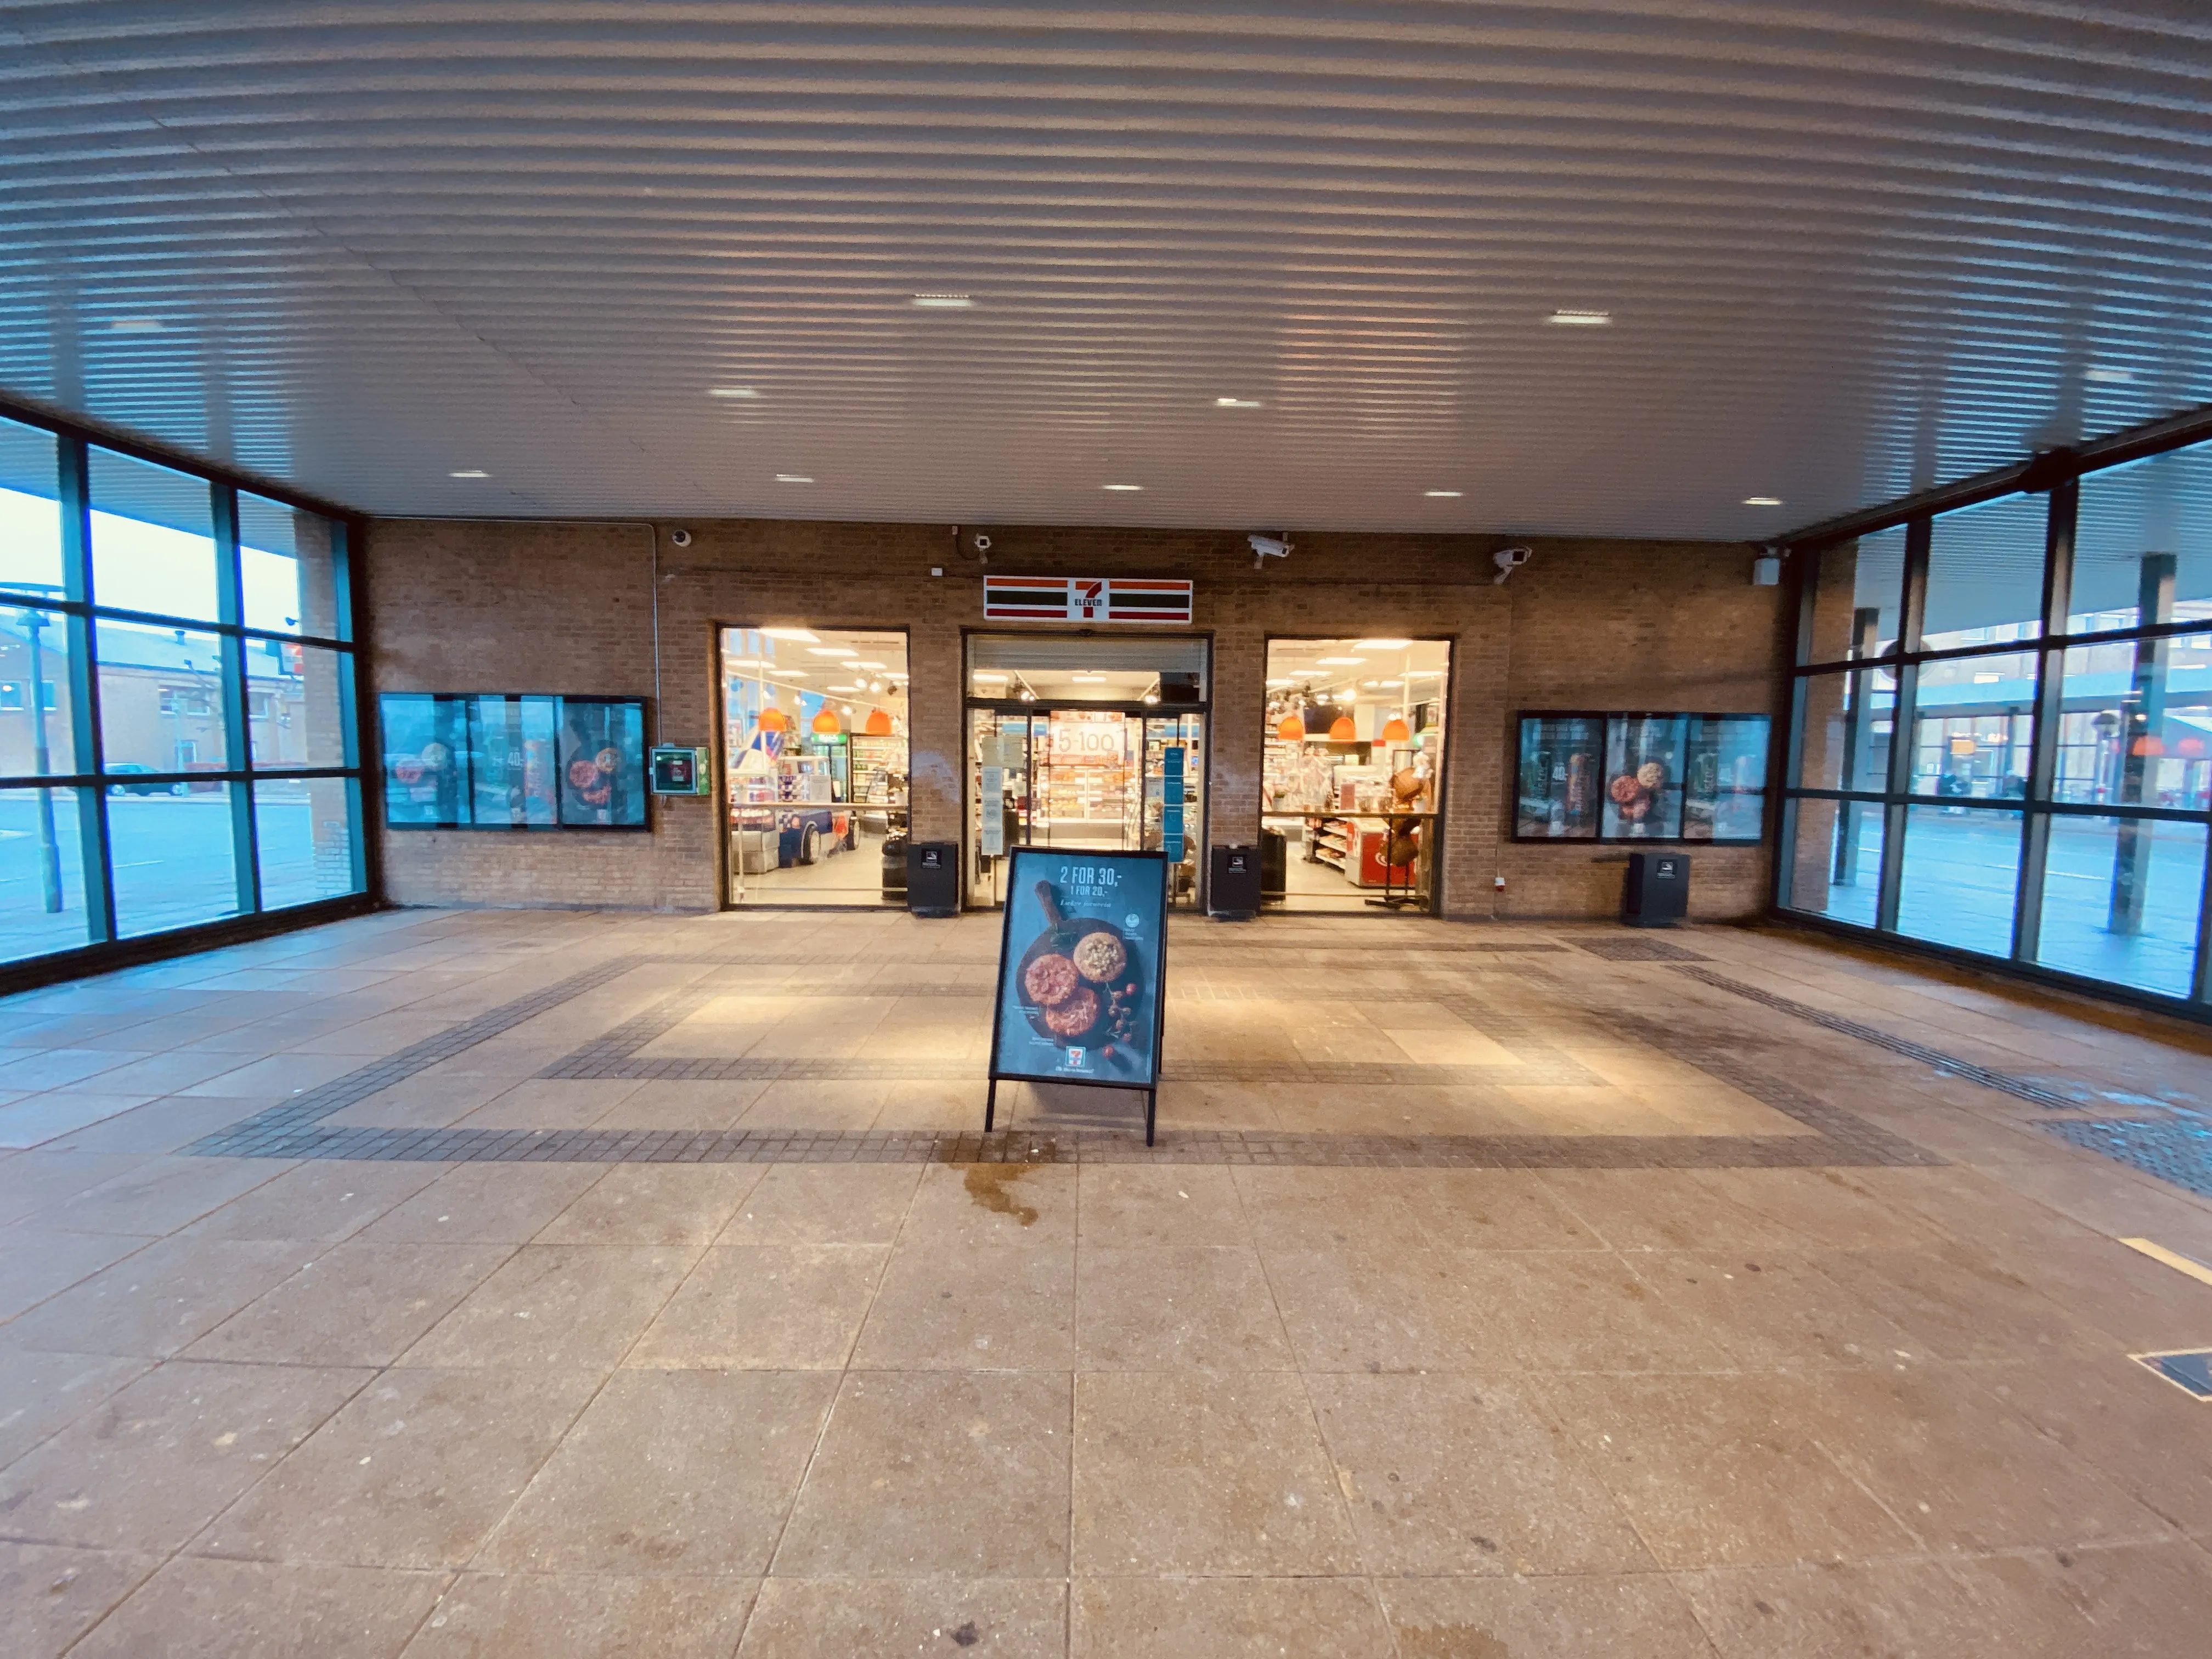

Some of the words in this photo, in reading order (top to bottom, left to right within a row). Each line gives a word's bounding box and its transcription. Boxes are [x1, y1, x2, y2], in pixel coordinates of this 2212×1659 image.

[1075, 580, 1102, 618] 7
[1059, 866, 1068, 883] 2
[1071, 866, 1094, 884] FOR
[1075, 885, 1091, 896] FOR
